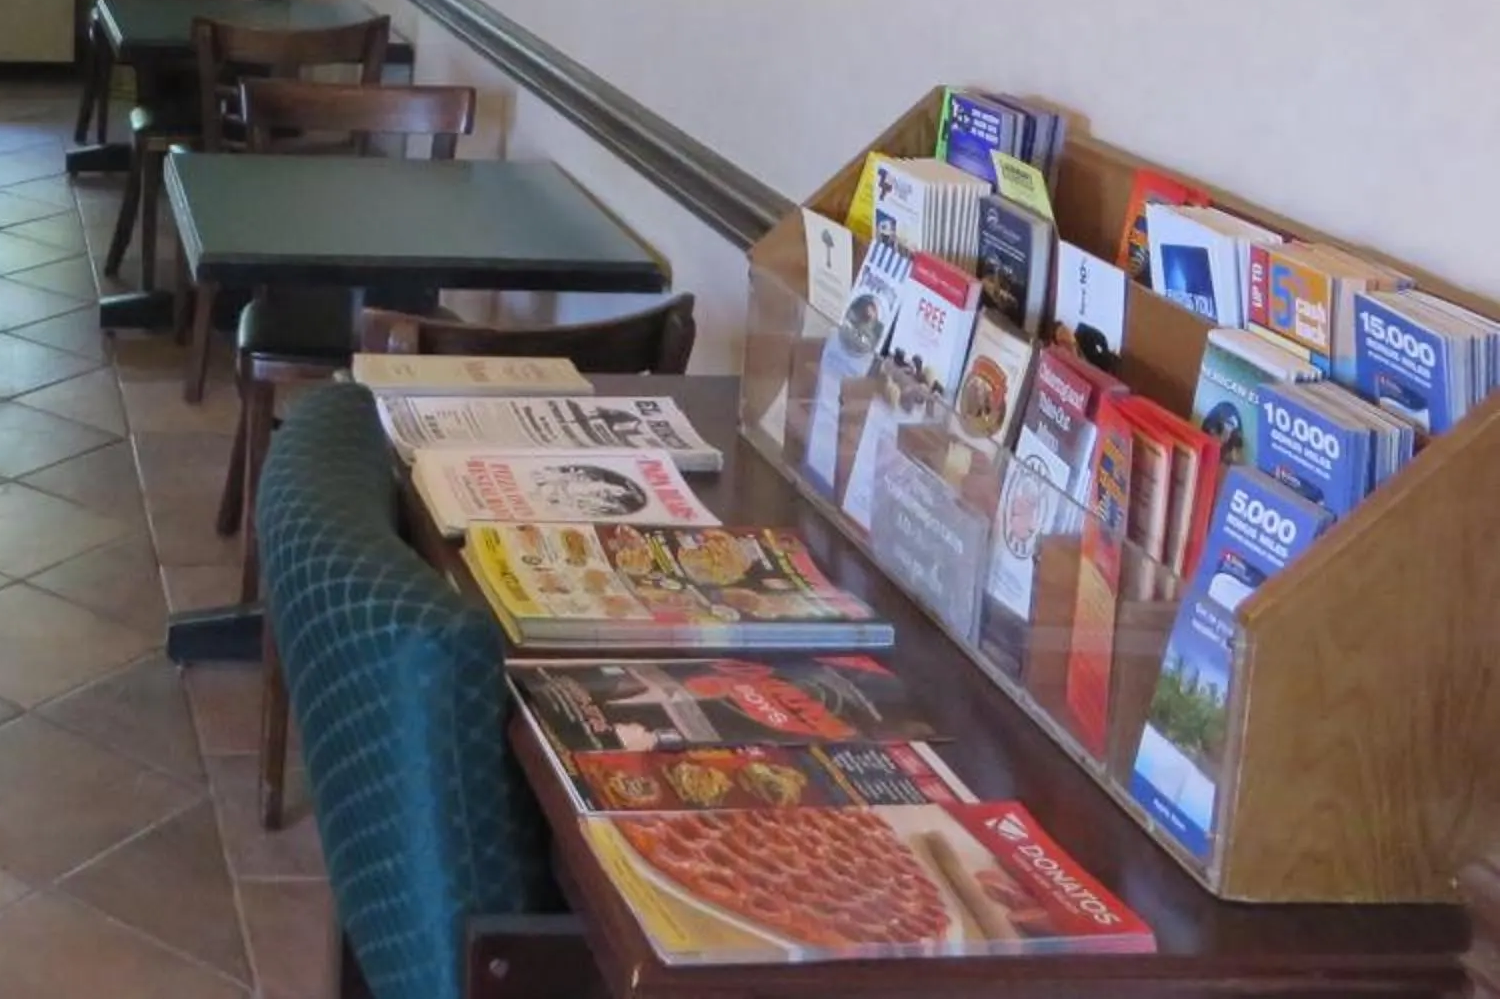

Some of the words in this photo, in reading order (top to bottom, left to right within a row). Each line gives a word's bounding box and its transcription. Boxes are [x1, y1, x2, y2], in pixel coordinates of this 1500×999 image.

[916, 297, 947, 333] FREE
[1359, 310, 1436, 368] 15,000
[1365, 336, 1400, 362] BONUS
[1401, 356, 1432, 380] MILES
[1263, 401, 1340, 460] 10,000
[1270, 428, 1303, 454] BONUS
[1303, 447, 1333, 470] MILES
[1225, 511, 1258, 539] BONUS
[1259, 533, 1289, 558] MILES
[1229, 488, 1297, 546] 5,000
[1017, 843, 1122, 926] DONATOS
